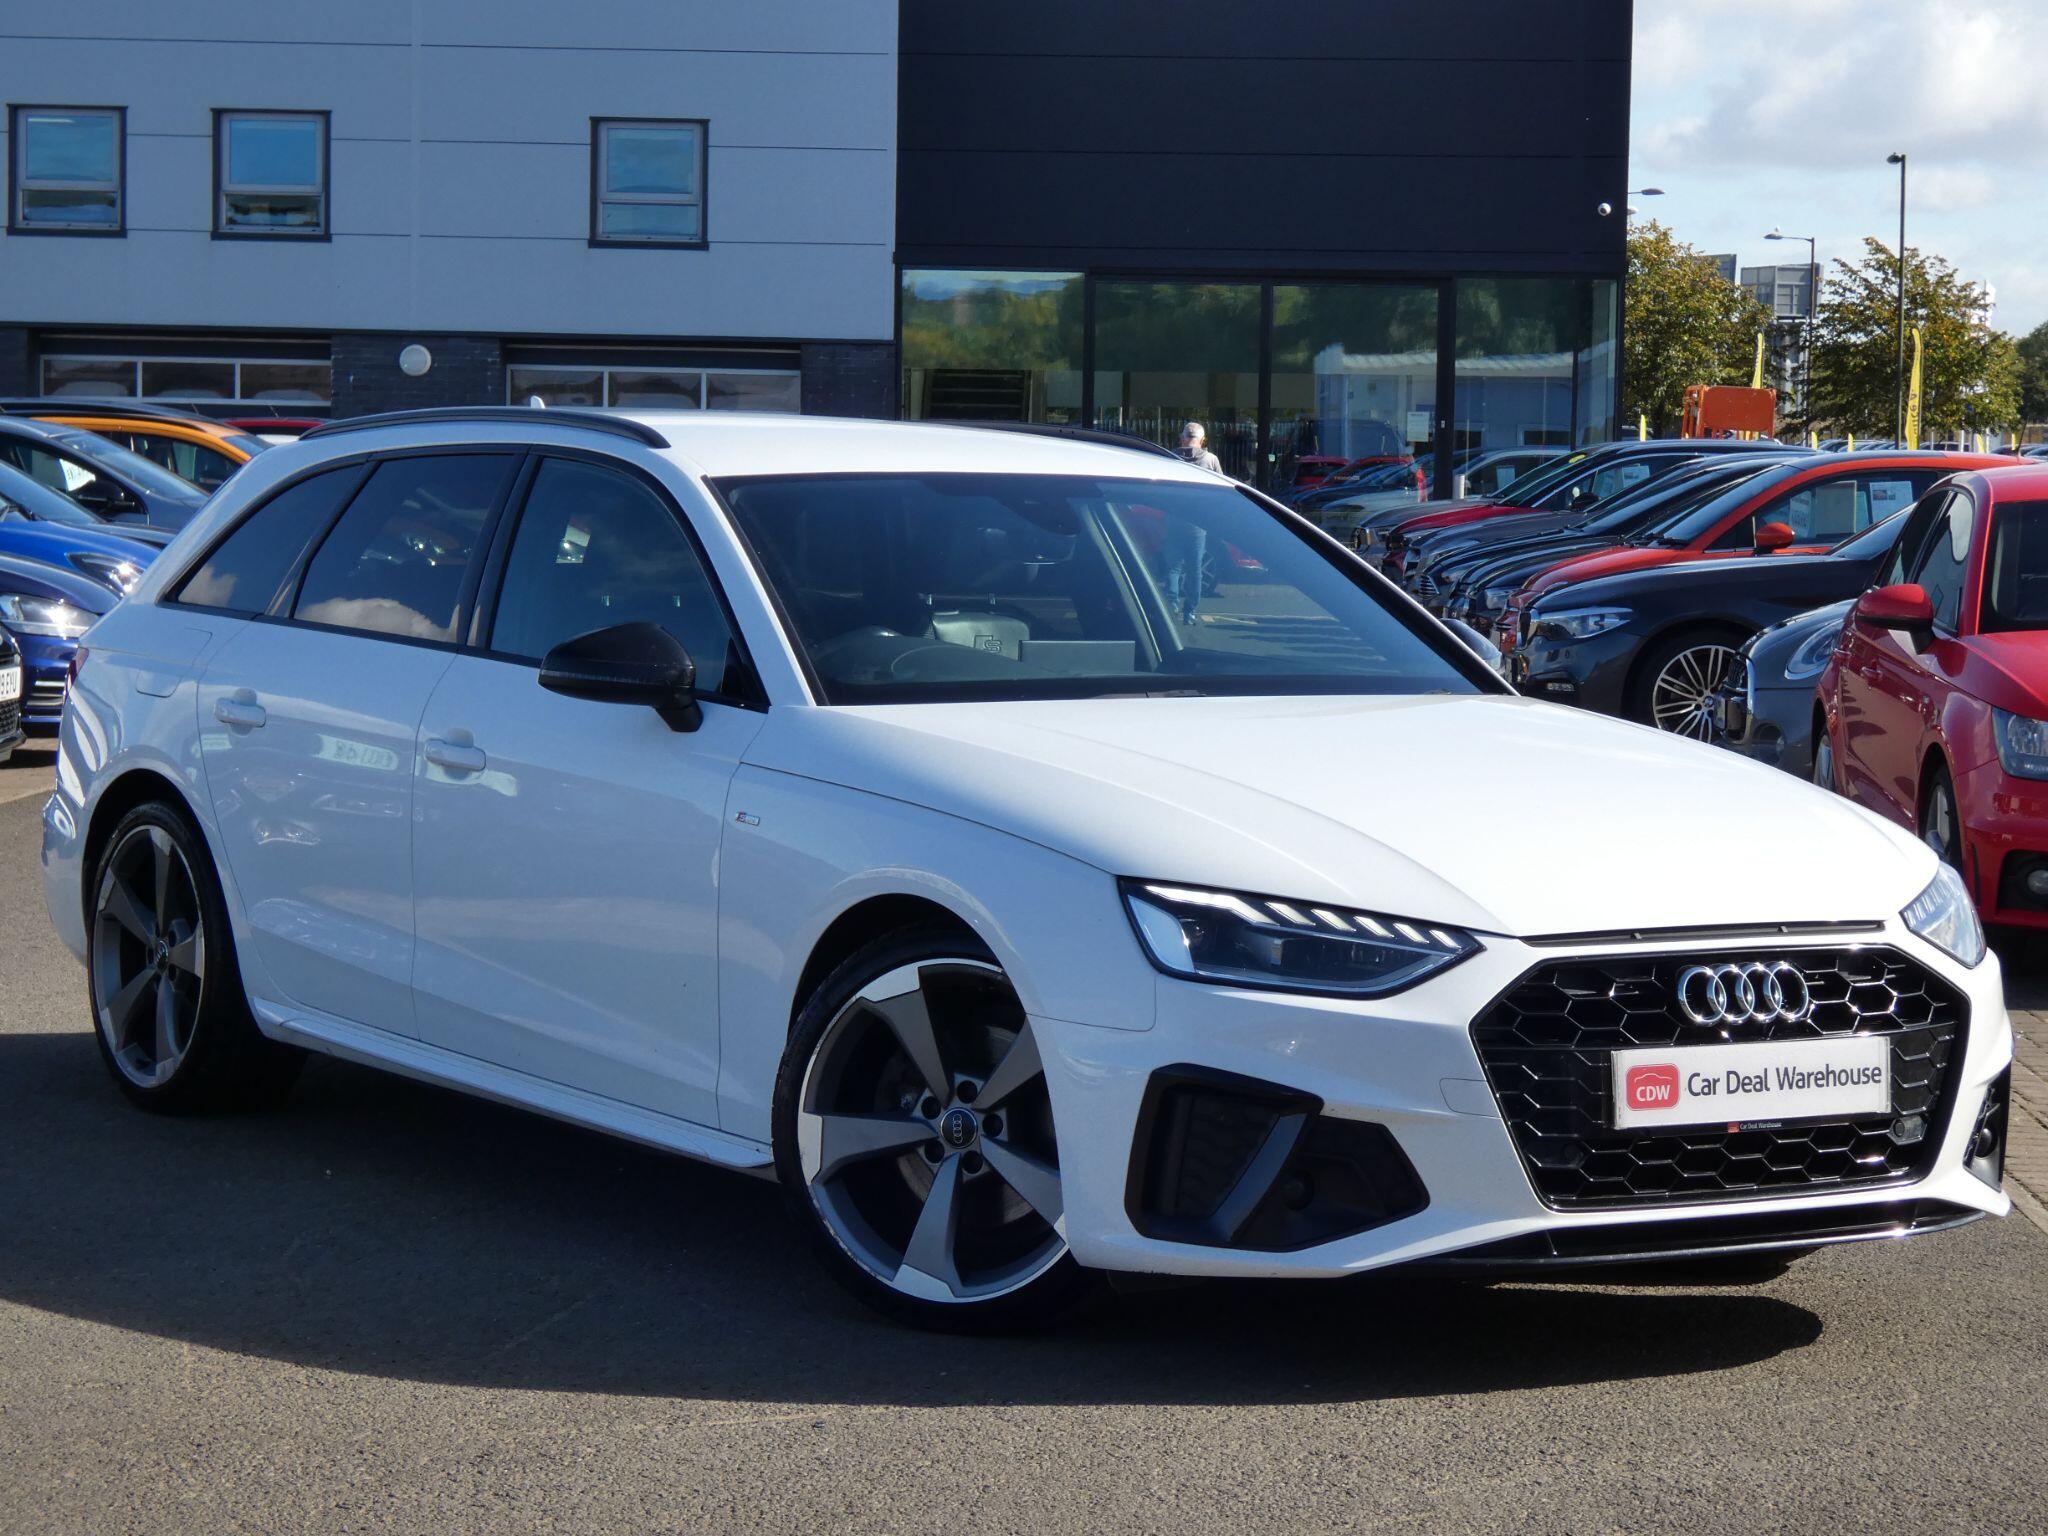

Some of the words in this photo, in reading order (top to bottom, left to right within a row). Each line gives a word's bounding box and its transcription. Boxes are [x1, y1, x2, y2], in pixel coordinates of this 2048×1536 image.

[1635, 1084, 1671, 1102] CDW
[1687, 1073, 1720, 1097] Car
[1726, 1067, 1770, 1095] Deal
[1775, 1063, 1883, 1092] Warehouse
